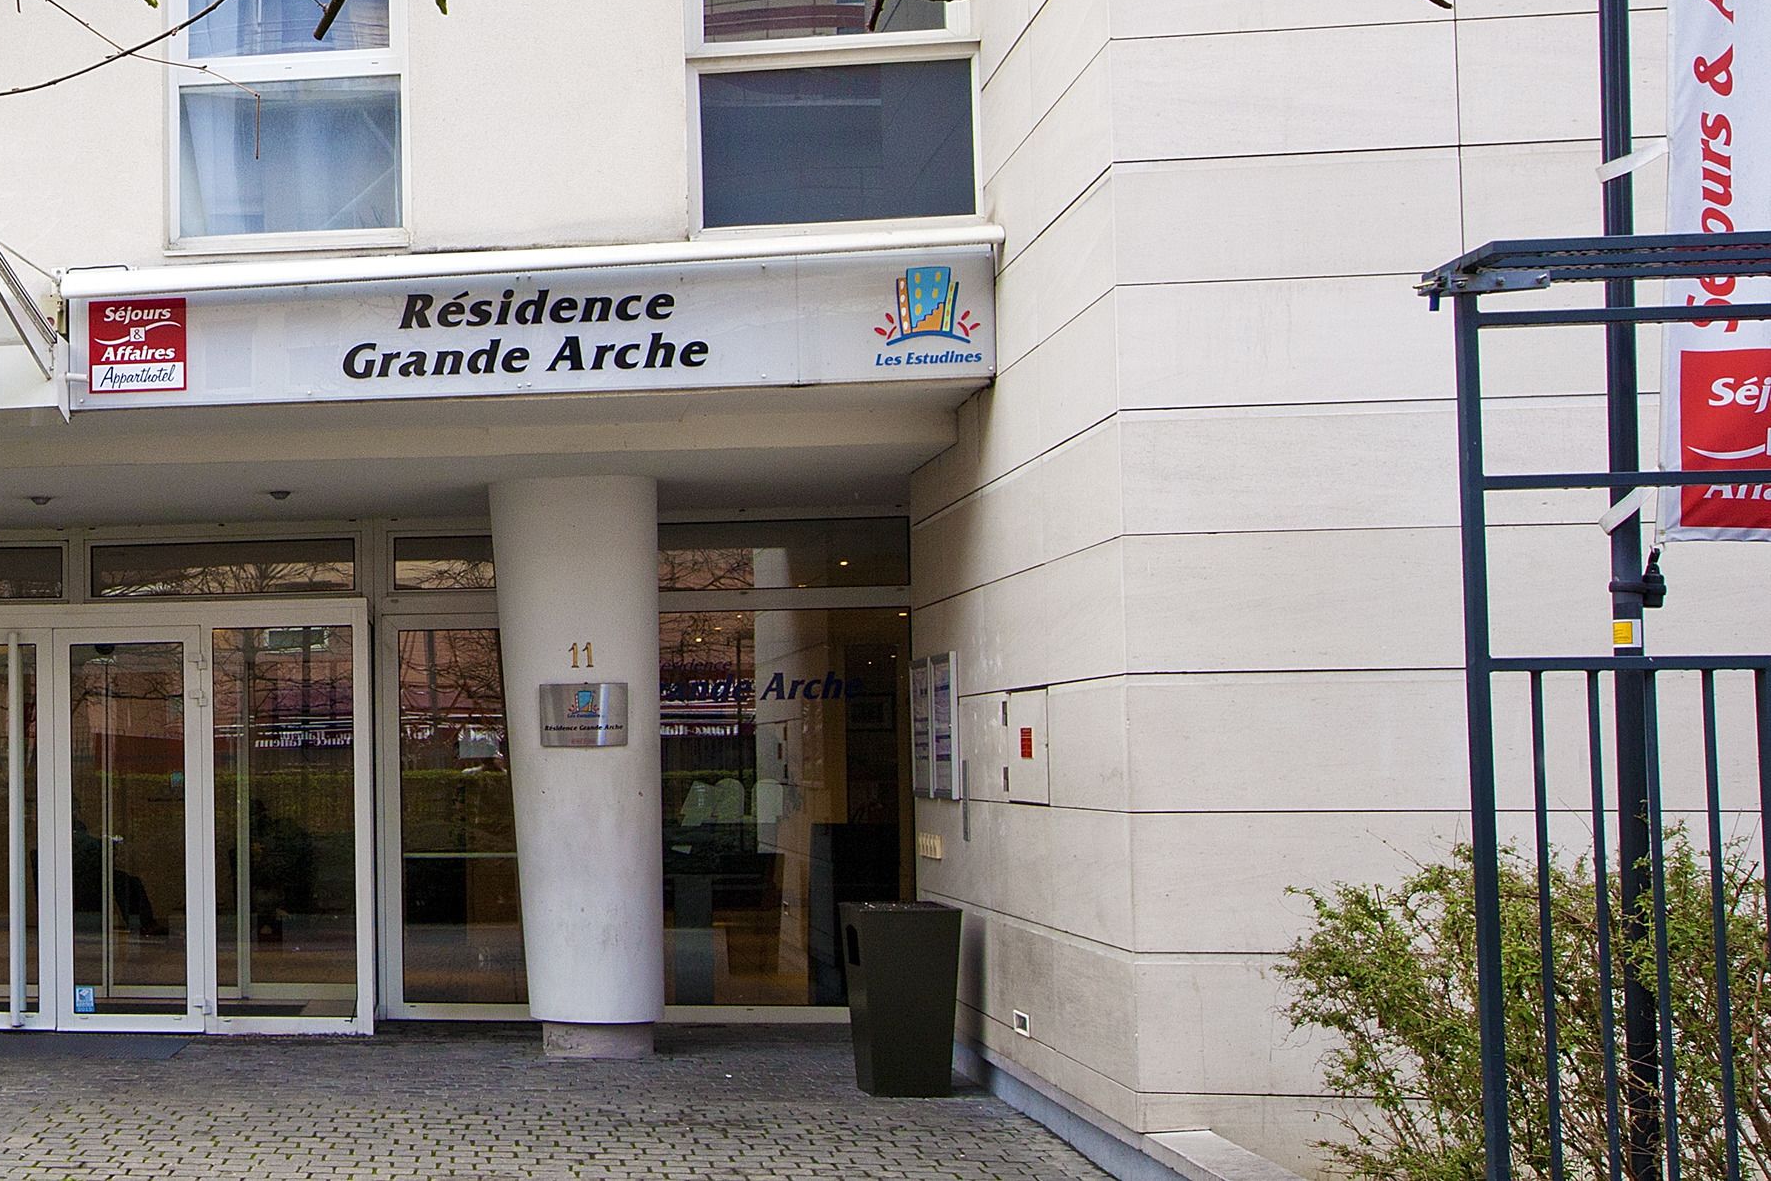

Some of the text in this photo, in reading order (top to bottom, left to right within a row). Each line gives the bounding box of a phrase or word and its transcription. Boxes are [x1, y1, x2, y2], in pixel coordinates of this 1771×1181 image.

[1693, 43, 1734, 96] &
[103, 306, 171, 325] Séjours
[398, 289, 675, 329] Résidence
[133, 328, 144, 340] &
[100, 345, 176, 362] Affaires
[342, 332, 709, 380] Grande Arche
[875, 350, 982, 366] Les Estudines
[568, 642, 594, 668] 11
[759, 671, 864, 701] Arche
